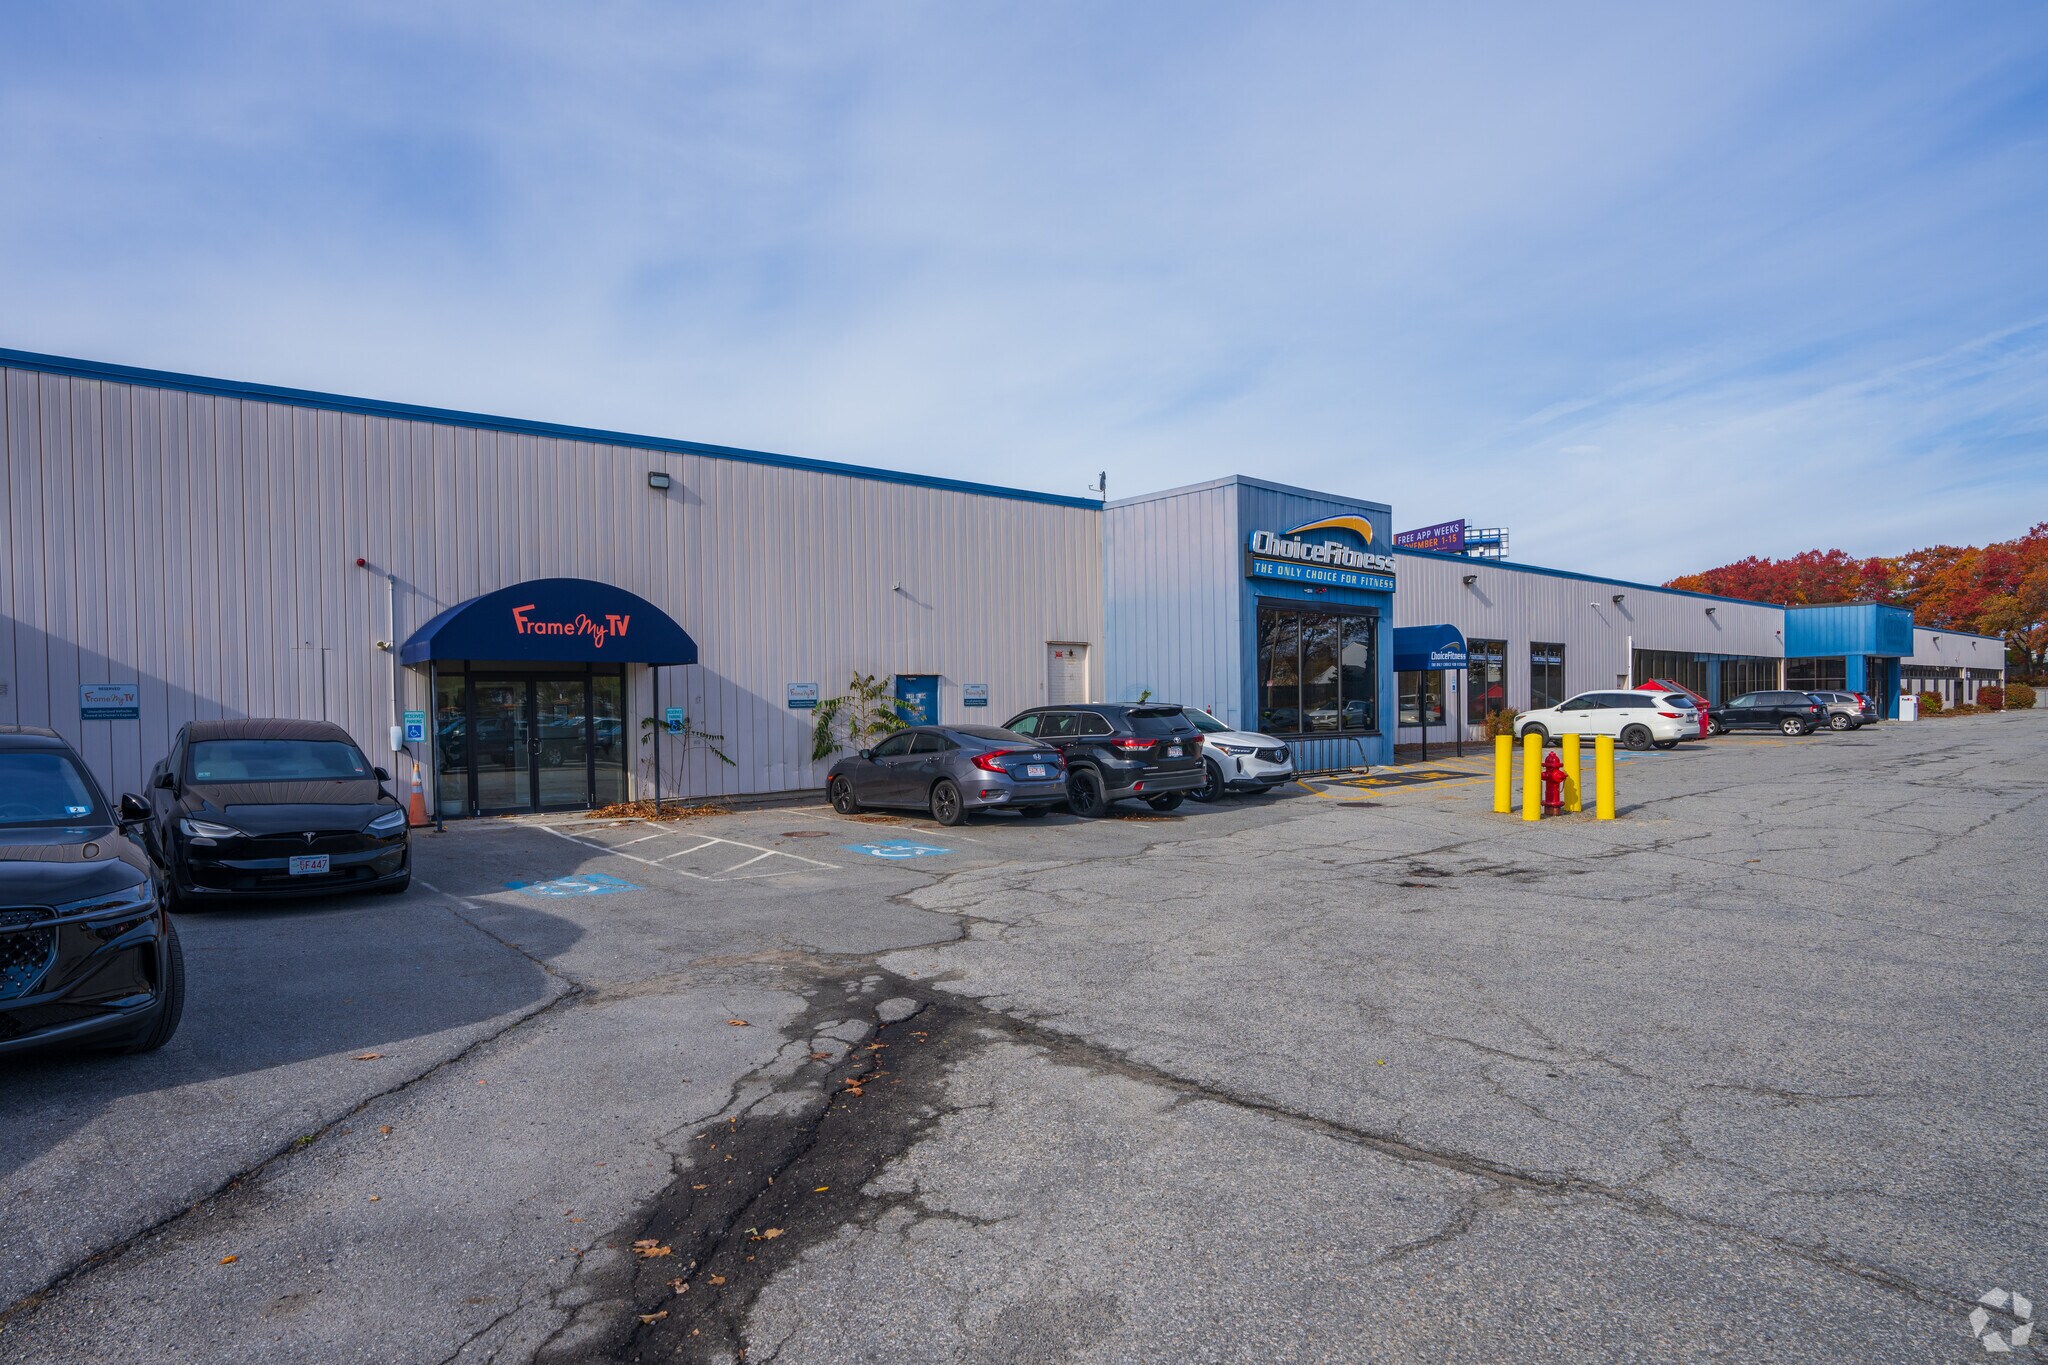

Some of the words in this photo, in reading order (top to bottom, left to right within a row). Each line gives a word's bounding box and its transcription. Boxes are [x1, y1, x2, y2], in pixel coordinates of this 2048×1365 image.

[1398, 533, 1414, 544] FREE
[1417, 530, 1431, 541] APP
[1434, 524, 1459, 536] WEEKS
[1442, 534, 1457, 544] 1-15
[1255, 563, 1273, 574] THE
[1278, 566, 1301, 577] ONLY
[1306, 569, 1337, 582] CHOICE
[1341, 574, 1357, 584] FOR
[1361, 577, 1394, 589] FITNESS
